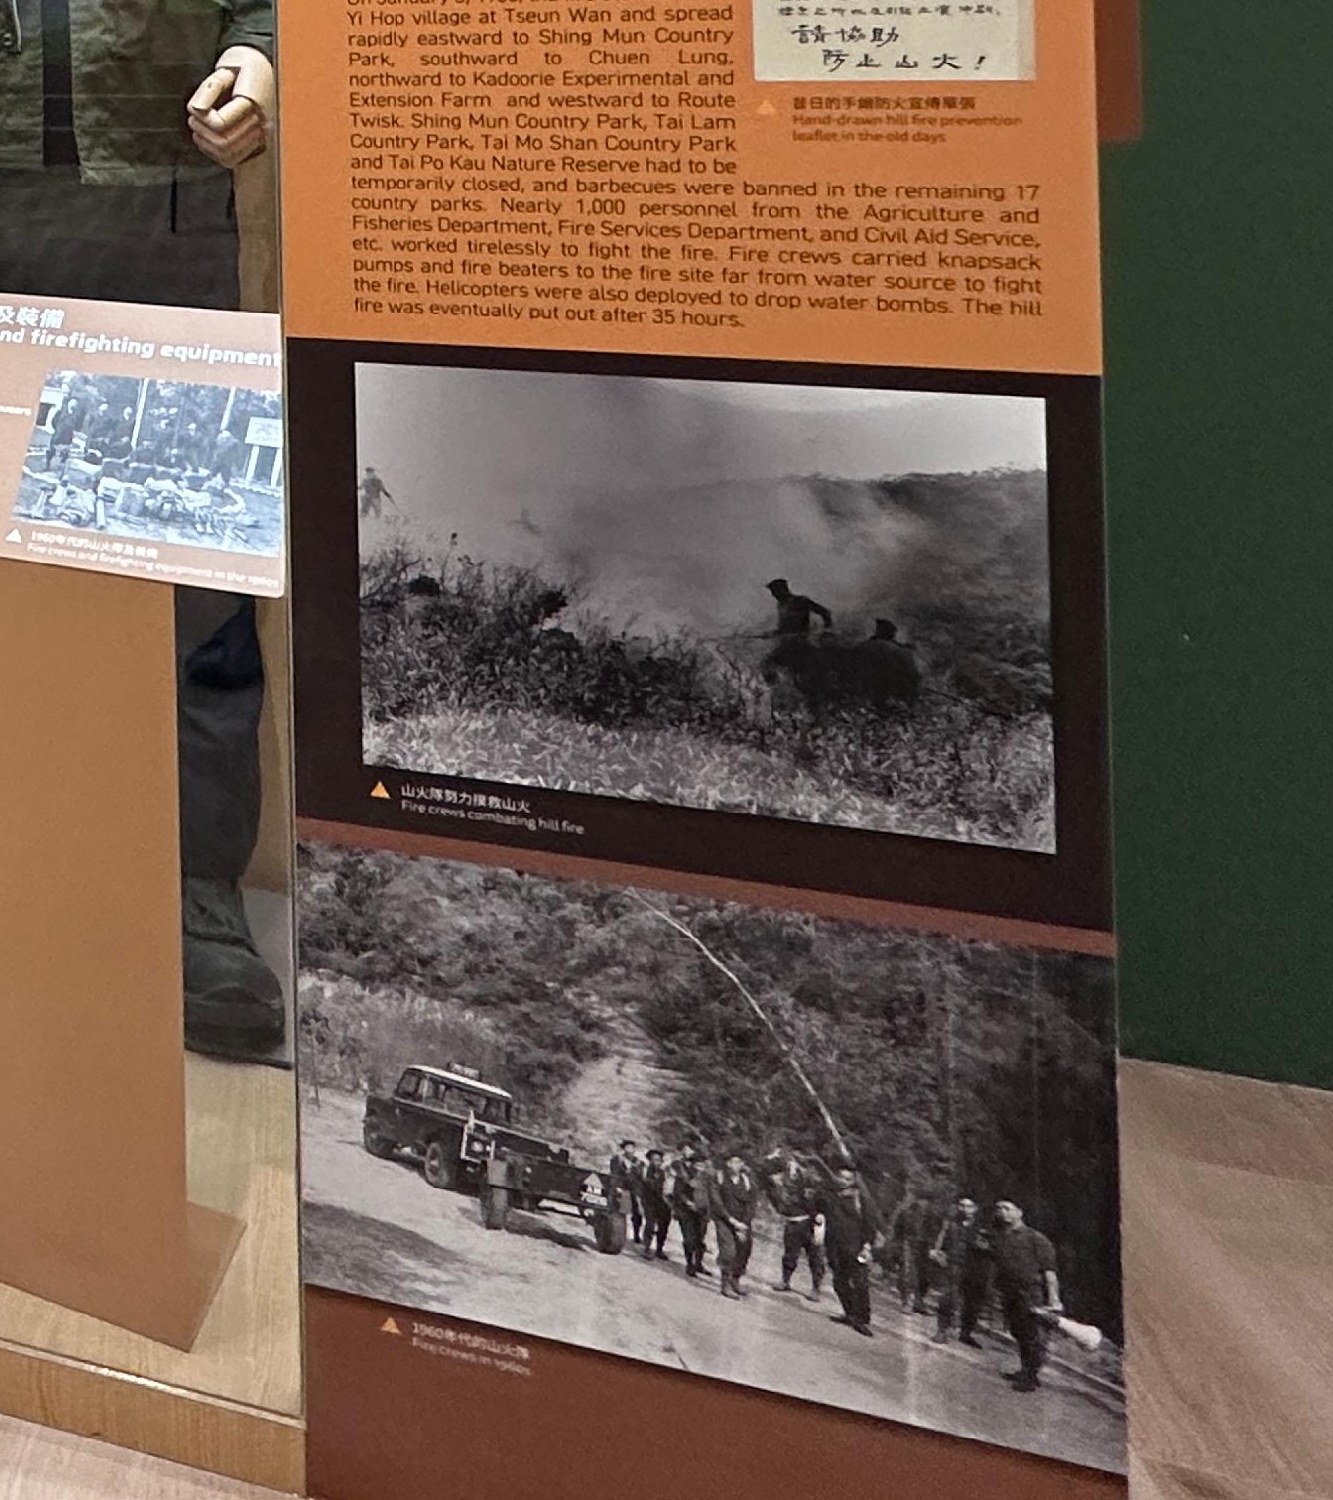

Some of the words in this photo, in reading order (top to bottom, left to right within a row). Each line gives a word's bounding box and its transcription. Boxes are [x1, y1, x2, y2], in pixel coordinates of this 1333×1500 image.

[346, 11, 362, 25] Yi
[371, 10, 404, 26] Hop
[411, 9, 470, 26] village
[479, 10, 496, 24] at
[504, 8, 559, 23] Tseun
[568, 7, 611, 22] Wan
[620, 6, 655, 21] and
[664, 5, 732, 22] spread
[348, 31, 408, 47] rapidly
[417, 29, 501, 45] eastward
[513, 31, 529, 44] to
[539, 29, 591, 45] Shing
[603, 28, 644, 43] Mun
[655, 27, 733, 44] Country
[31, 329, 154, 357] firefighting
[160, 343, 282, 370] equipment
[401, 800, 425, 812] Fire
[428, 805, 465, 817] crews
[467, 811, 536, 829] combating
[538, 817, 559, 830] hill
[561, 820, 583, 833] fire
